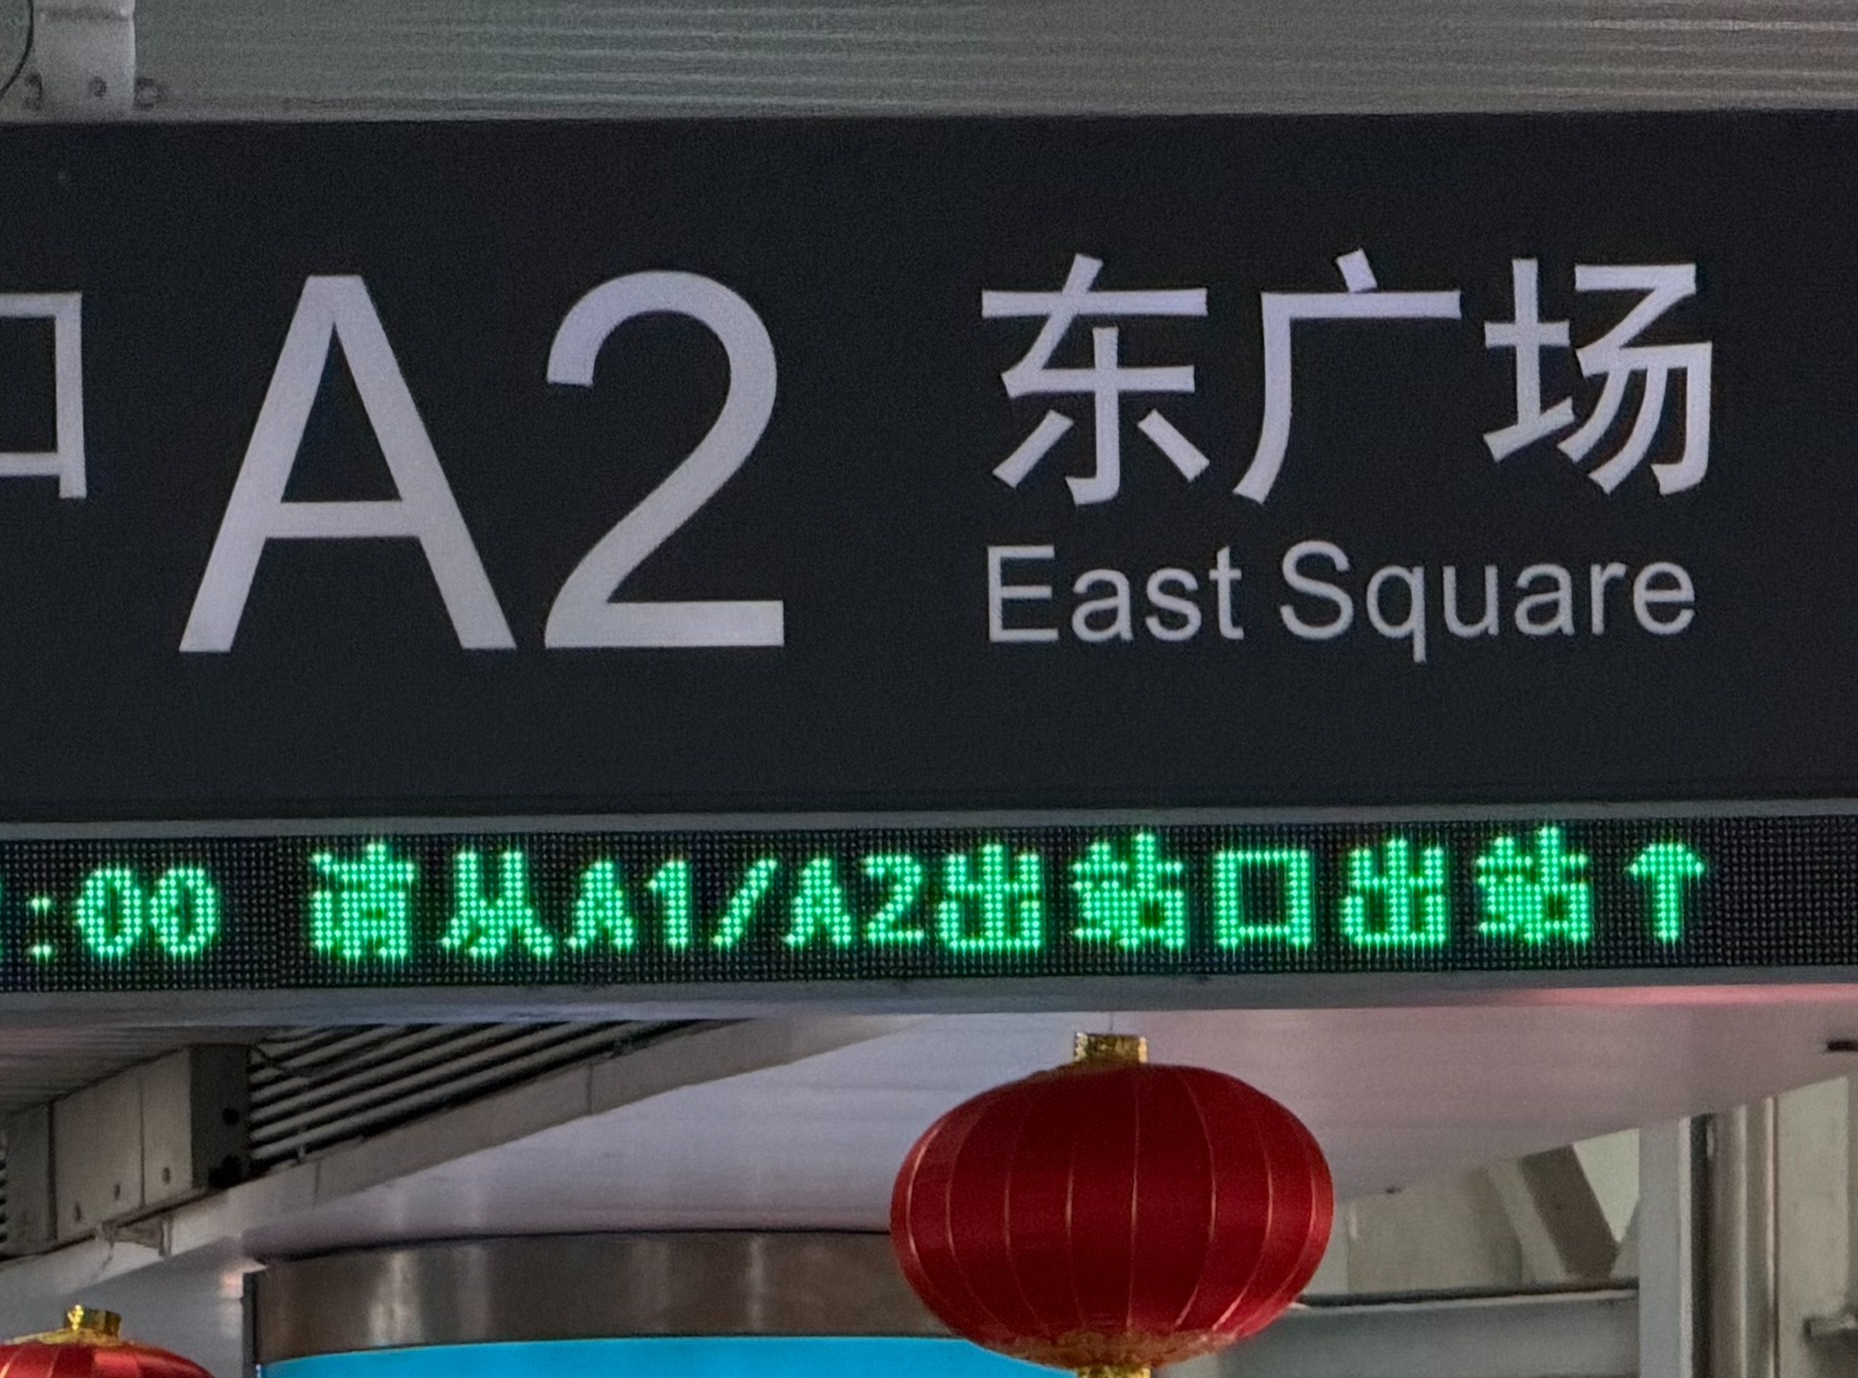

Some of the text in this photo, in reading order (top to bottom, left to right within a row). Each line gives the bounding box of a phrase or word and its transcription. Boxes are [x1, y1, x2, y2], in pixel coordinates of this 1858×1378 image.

[177, 270, 785, 652] A2
[980, 247, 1714, 506] 东广场
[986, 540, 1696, 663] East Square
[311, 826, 1591, 957] 请从A1/A2出站口出站
